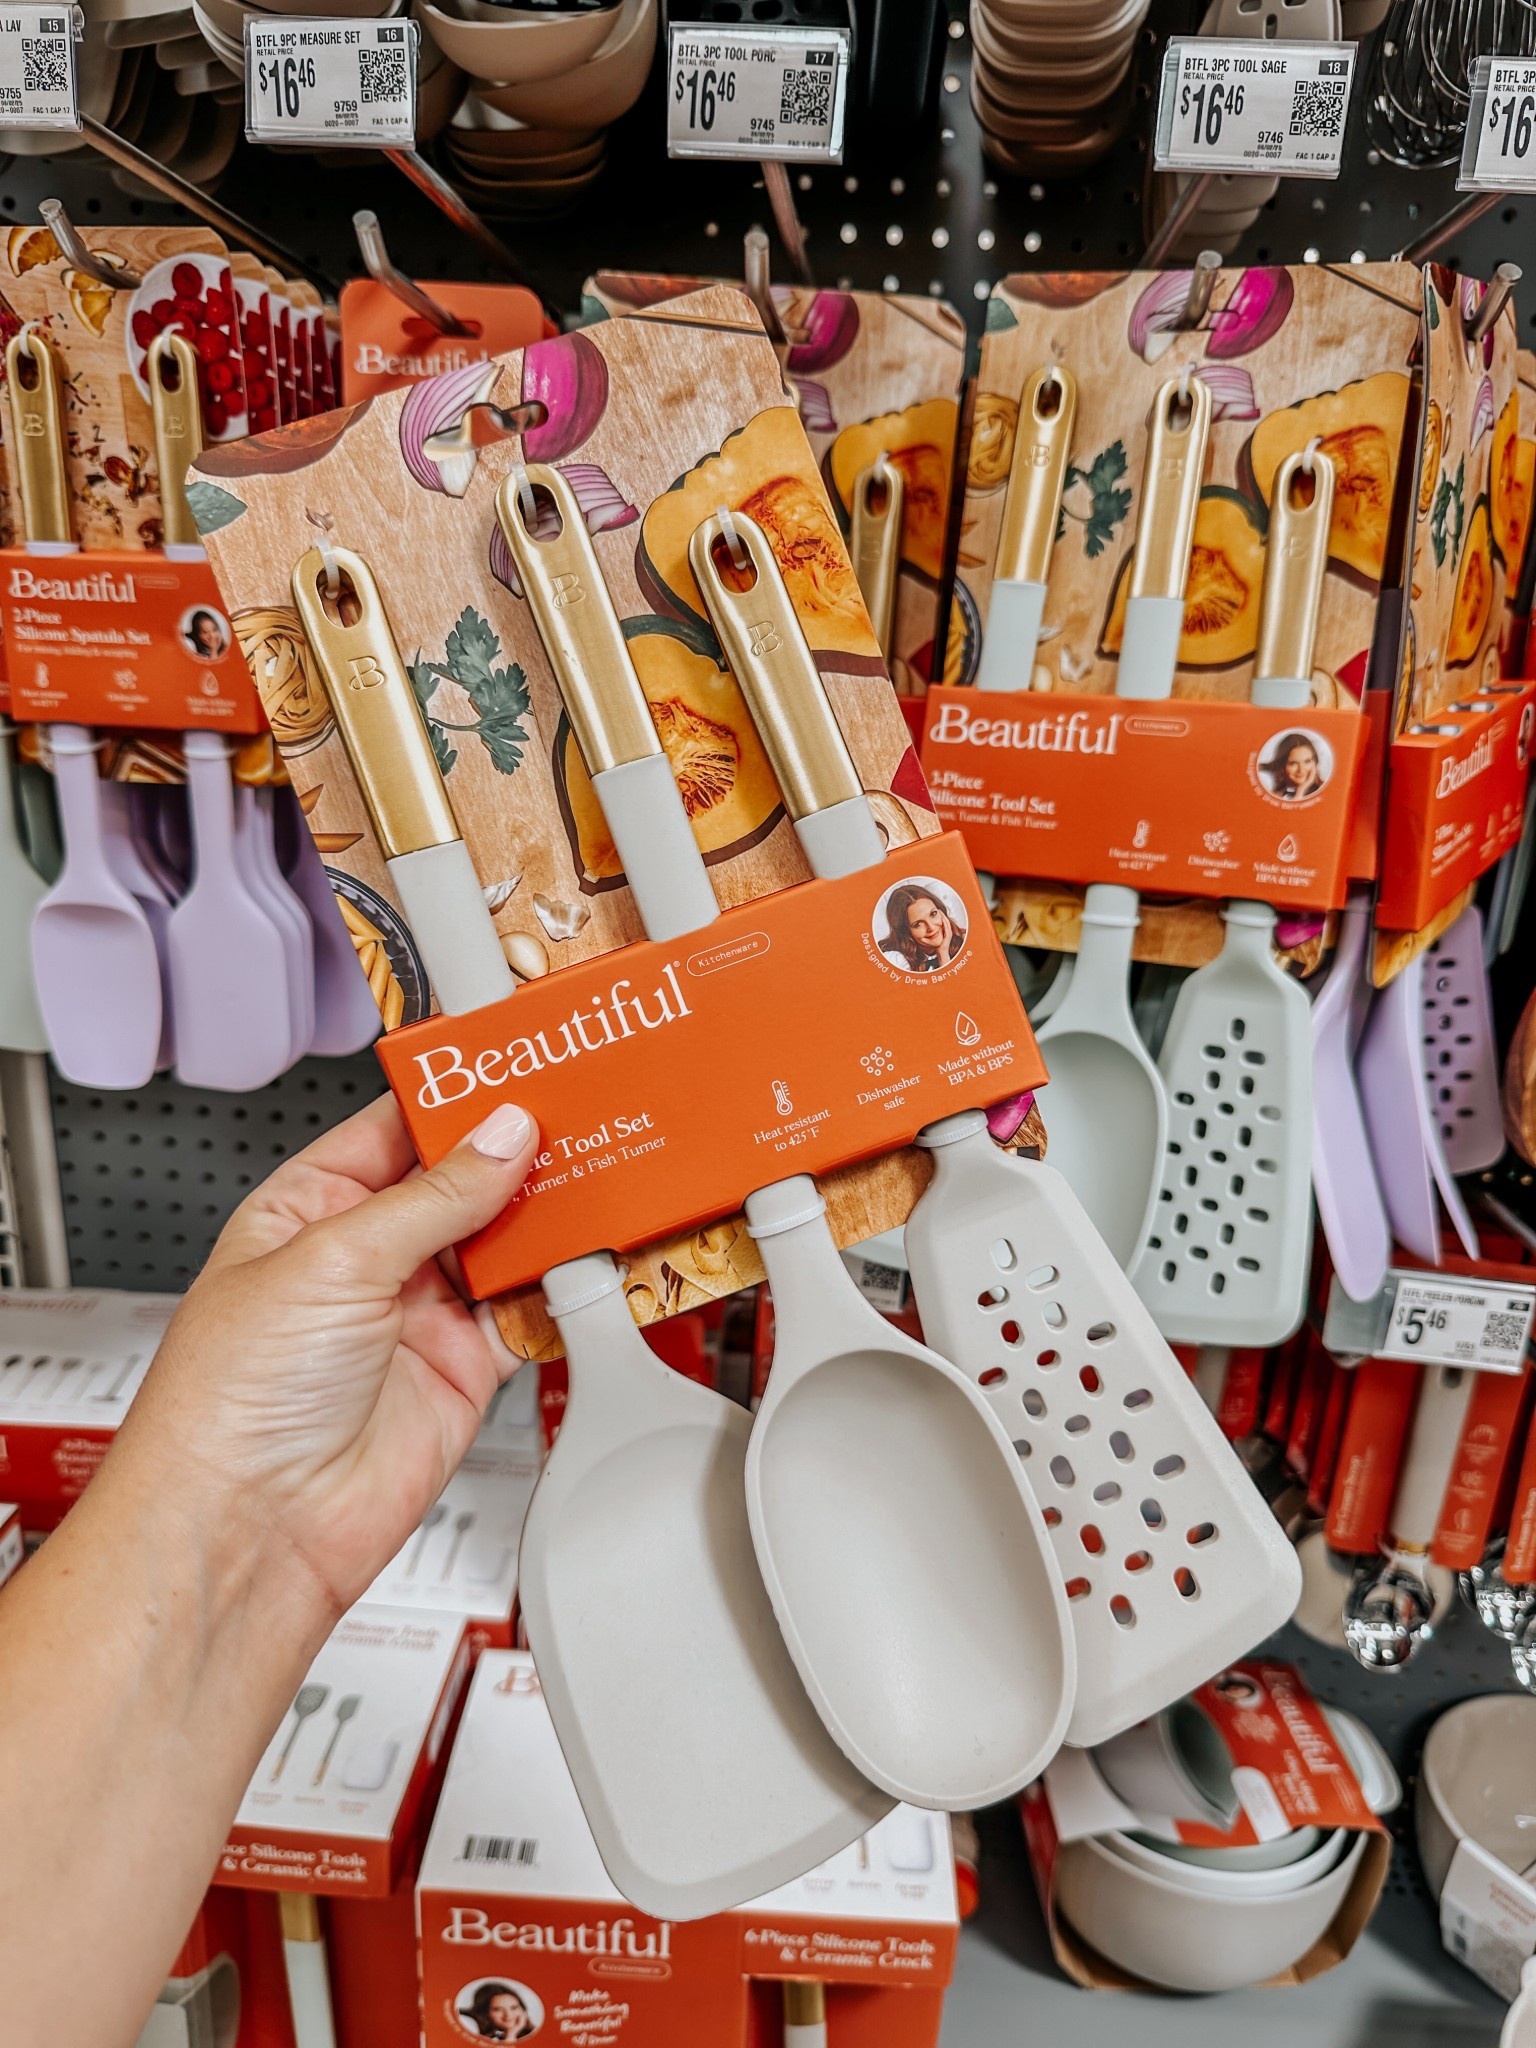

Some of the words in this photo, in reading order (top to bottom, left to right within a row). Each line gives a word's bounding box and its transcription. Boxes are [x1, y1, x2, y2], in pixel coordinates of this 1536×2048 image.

[6, 20, 21, 32] LAV
[47, 20, 59, 32] 15
[384, 29, 397, 41] 16
[256, 34, 278, 47] BTFL
[280, 33, 297, 46] 9PC
[300, 32, 341, 46] MEASURE
[344, 31, 361, 44] SET
[679, 44, 700, 58] BTFL
[704, 45, 721, 59] 3PC
[724, 46, 748, 61] TOOL
[814, 54, 826, 64] 17
[1185, 58, 1208, 71] BTFL
[1211, 58, 1230, 72] 3PC
[1234, 59, 1258, 73] TOOL
[1261, 60, 1287, 74] SAGE
[1328, 62, 1341, 74] 18
[1183, 72, 1205, 80] RETAIL
[1206, 73, 1225, 81] PRICE
[1496, 70, 1520, 83] BTFL
[1523, 70, 1536, 83] 3P
[0, 88, 22, 99] 9755
[1518, 85, 1535, 93] PRICE
[334, 100, 358, 112] 9759
[372, 118, 383, 126] FAC
[750, 119, 775, 131] 9745
[1257, 131, 1284, 144] 9746
[1296, 152, 1308, 160] FAC
[8, 568, 137, 604] Beautiful
[551, 572, 587, 609] B
[15, 625, 70, 642] Silicone
[70, 627, 126, 645] Spatula
[126, 630, 152, 646] Set
[747, 620, 784, 657] B
[348, 655, 386, 692] B
[930, 703, 1124, 755] Beautiful
[989, 792, 1026, 813] Tool
[1027, 796, 1057, 815] Set
[958, 810, 990, 823] Turner
[990, 813, 1000, 825] &
[1001, 814, 1023, 827] Fish
[1024, 816, 1057, 830] Turner
[697, 939, 760, 969] Kitchenware
[861, 932, 890, 973] Designed
[890, 970, 902, 982] by
[905, 975, 928, 985] Drew
[931, 950, 973, 984] Barrymore
[937, 1055, 971, 1075] Made
[972, 1038, 1015, 1062] without
[948, 1070, 976, 1086] BPA
[976, 1064, 987, 1076] &
[988, 1053, 1014, 1072] BPS
[856, 1073, 921, 1105] Dishwasher
[884, 1095, 905, 1111] safe
[753, 1126, 783, 1144] Heat
[783, 1108, 831, 1133] resistant
[555, 1124, 612, 1159] Tool
[613, 1112, 655, 1138] Set
[774, 1141, 787, 1153] to
[522, 1171, 569, 1198] Turner
[571, 1165, 585, 1178] &
[586, 1153, 617, 1173] Fish
[618, 1135, 667, 1161] Turner
[249, 1842, 317, 1863] Silicone
[317, 1849, 368, 1867] Tools
[222, 1855, 239, 1871] &
[239, 1857, 312, 1878] Ceramic
[313, 1864, 368, 1882] Crock
[441, 1906, 671, 1959] Beautiful
[744, 1928, 809, 1947] 6-Piece
[811, 1931, 882, 1951] Silicone
[884, 1936, 936, 1954] Tools
[779, 1946, 797, 1963] &
[799, 1947, 875, 1968] Ceramic
[877, 1951, 934, 1970] Crock
[568, 1988, 611, 2003] Make
[553, 2001, 630, 2019] Something
[559, 2015, 623, 2033] Beautiful
